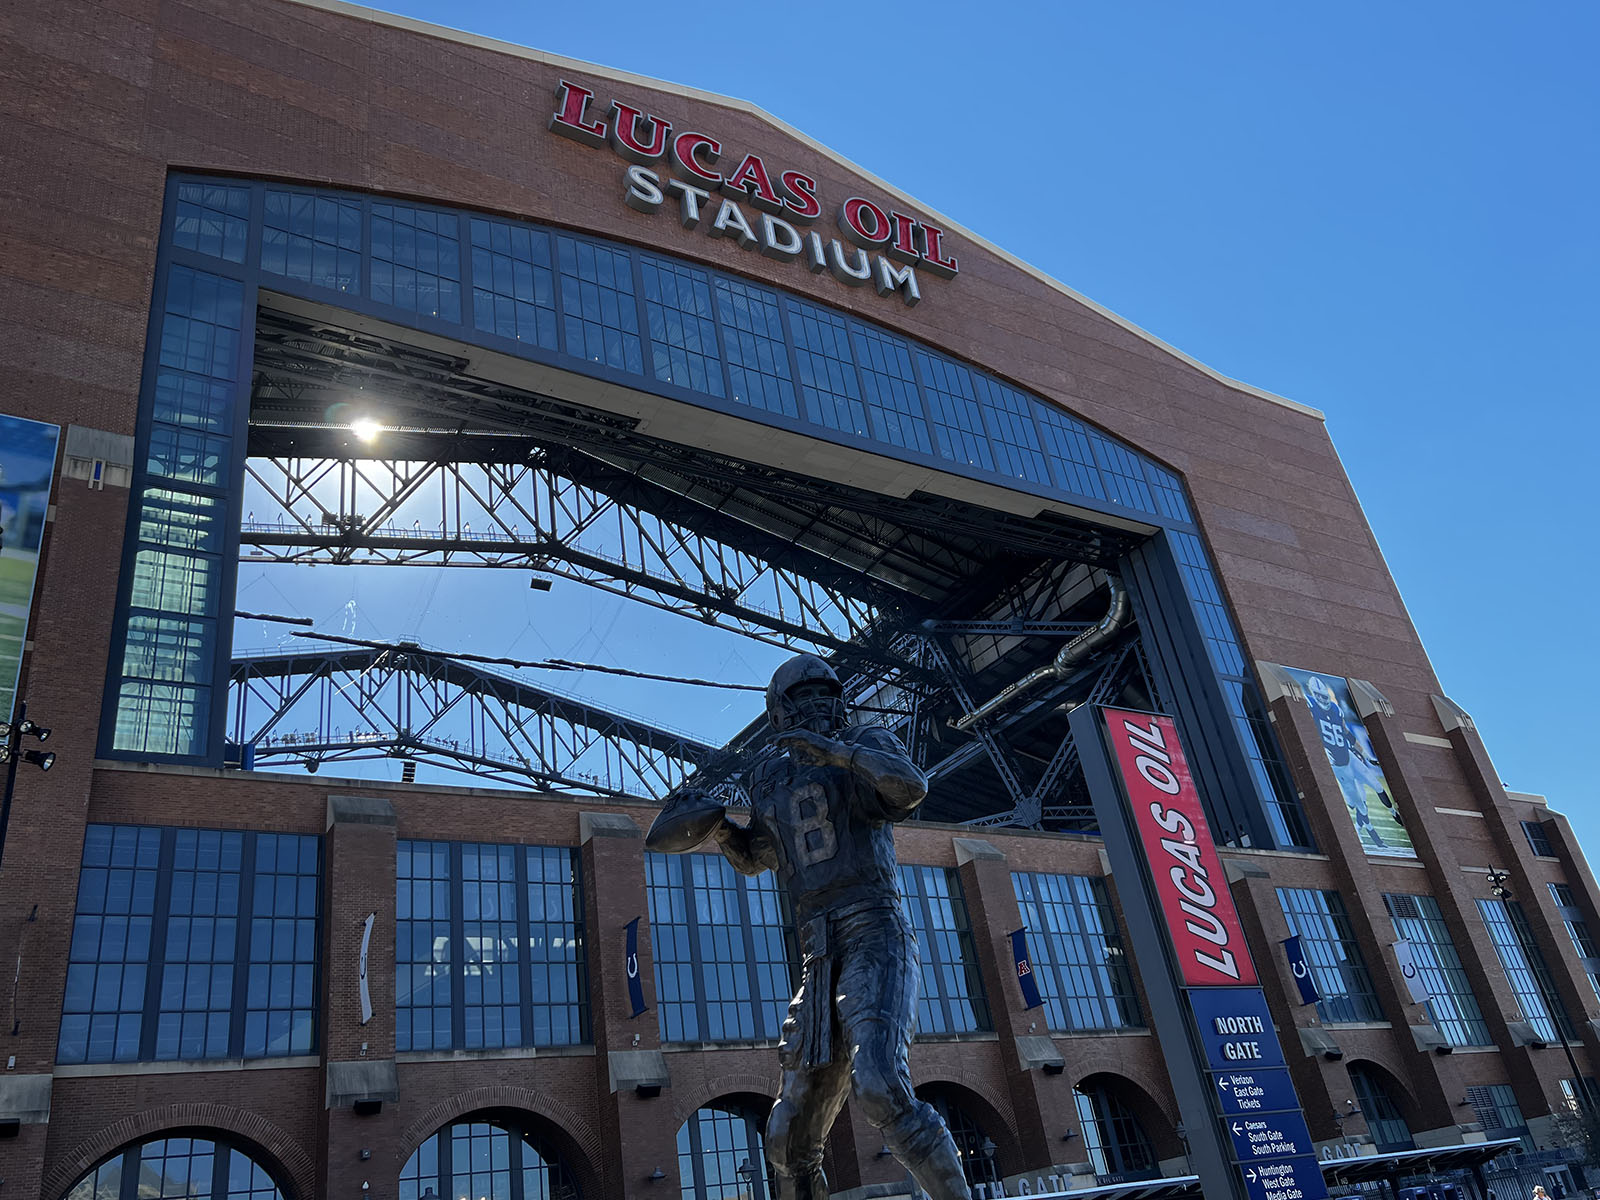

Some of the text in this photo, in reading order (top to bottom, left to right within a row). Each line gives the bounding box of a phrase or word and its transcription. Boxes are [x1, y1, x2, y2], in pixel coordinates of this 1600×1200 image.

[550, 79, 959, 277] LUCAS OIL
[623, 164, 922, 308] STADIUM
[1318, 718, 1345, 748] 56
[1123, 719, 1241, 981] LUCAS OIL
[1017, 960, 1031, 977] A
[1215, 1016, 1264, 1034] NORTH
[1225, 1041, 1262, 1060] GATE
[1230, 1075, 1254, 1085] Verizon
[1234, 1086, 1264, 1097] East Gate
[1238, 1099, 1261, 1109] Tickets
[1245, 1121, 1267, 1130] Caesars
[1248, 1130, 1283, 1143] South Gate
[1252, 1142, 1296, 1155] South Parking
[1258, 1164, 1293, 1177] Huntington
[1263, 1176, 1295, 1189] West Gate
[1267, 1188, 1303, 1200] Media Gate
